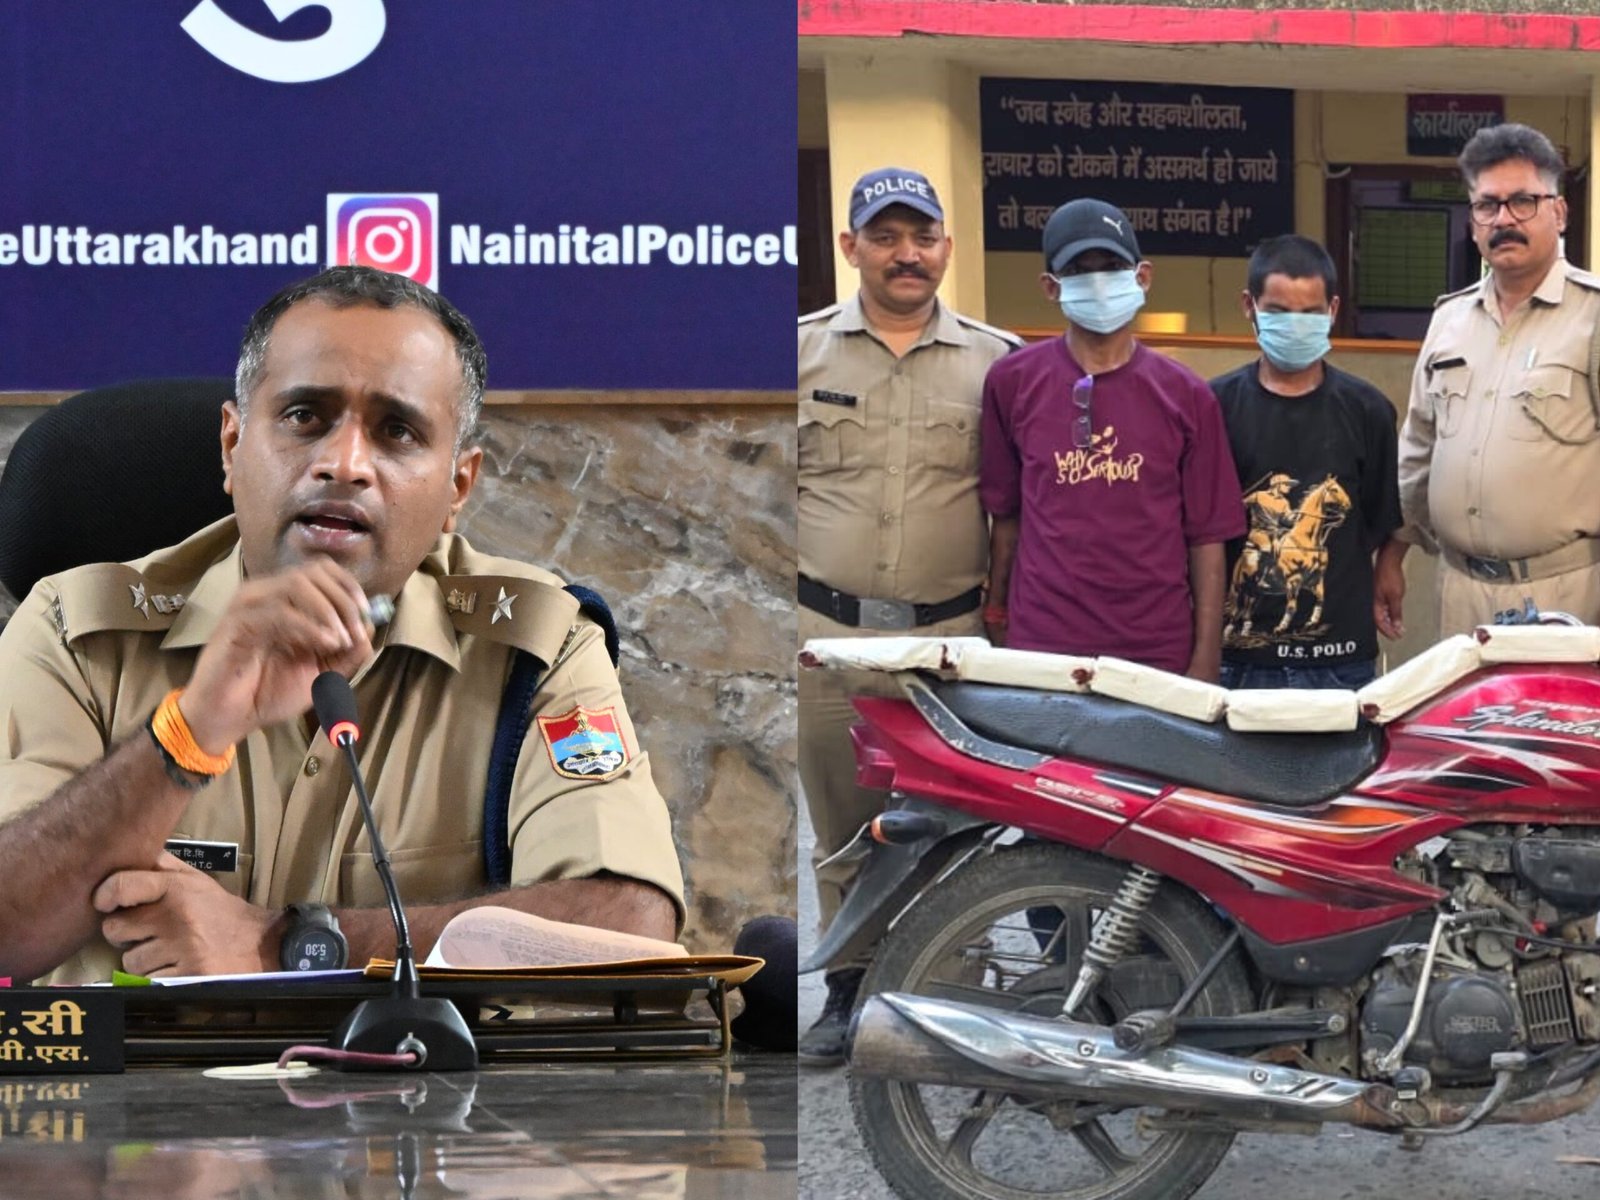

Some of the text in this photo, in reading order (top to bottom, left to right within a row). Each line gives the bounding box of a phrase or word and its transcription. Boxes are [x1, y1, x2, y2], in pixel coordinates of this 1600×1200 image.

[1052, 92, 1093, 128] स्नेह
[1097, 91, 1134, 127] और
[1037, 144, 1063, 177] को
[1067, 144, 1117, 179] रोकने
[1122, 146, 1142, 179] में
[1144, 147, 1210, 180] असमर्थ
[1213, 149, 1233, 184] हो
[1239, 149, 1278, 183] जाये
[864, 178, 930, 203] POLICE
[997, 196, 1018, 229] तो
[1163, 198, 1211, 234] संगत
[0, 225, 317, 265] eUttarakhand
[1277, 641, 1356, 658] U.S. POLO
[0, 1000, 87, 1036] .सी
